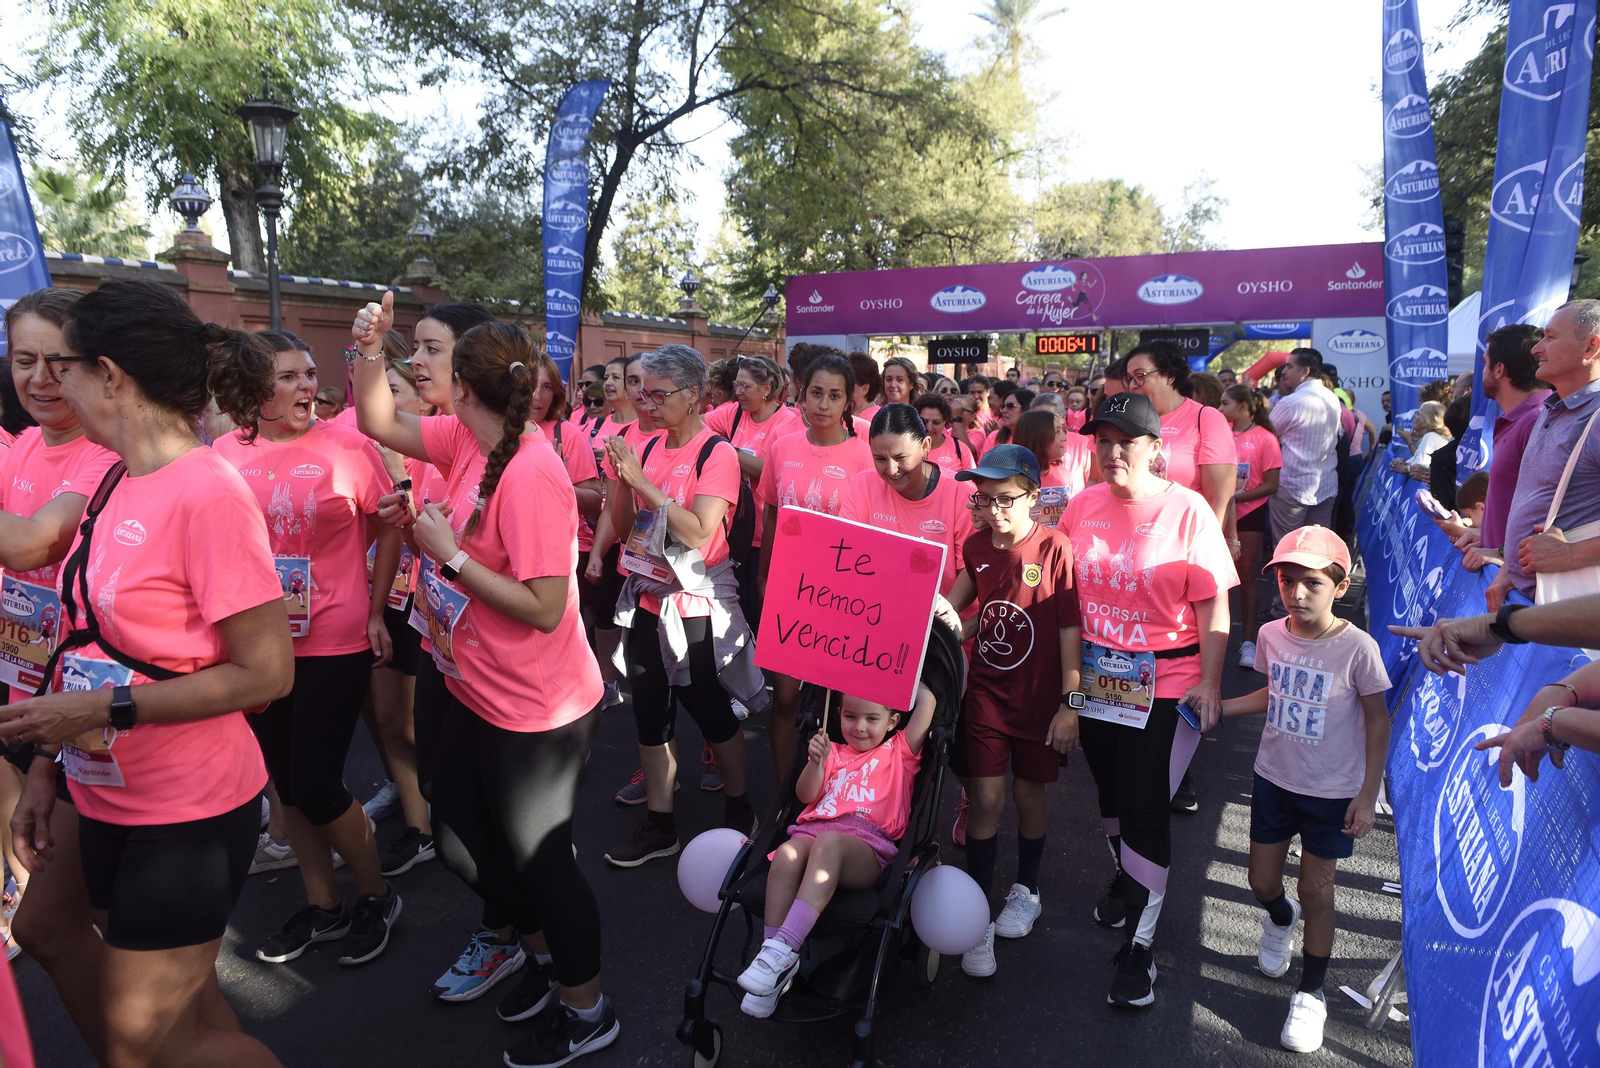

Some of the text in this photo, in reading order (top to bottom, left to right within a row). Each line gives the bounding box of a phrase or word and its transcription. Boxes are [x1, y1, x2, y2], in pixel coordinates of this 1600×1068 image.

[547, 258, 581, 270] STURIANA
[1025, 276, 1073, 287] ASTURIANA
[1237, 279, 1293, 294] OYSHO
[1327, 279, 1384, 291] Santander
[1015, 290, 1062, 305] Carrera
[1141, 287, 1198, 298] ASTURIANA
[547, 301, 578, 313] TURIANA
[860, 298, 903, 311] OYSHO
[934, 296, 982, 307] ASTURIANA
[796, 304, 835, 314] Santander
[1026, 301, 1079, 325] de la Mujer
[1331, 339, 1381, 350] ASTURIANA
[937, 346, 980, 358] OYSHO
[1338, 376, 1385, 389] YSHO
[783, 461, 804, 469] OYSHO
[1080, 519, 1111, 530] OYSHO
[830, 538, 876, 576] te
[983, 606, 1028, 631] ANDEX
[1087, 601, 1150, 623] DORSAL
[1083, 615, 1149, 647] UMA
[1, 641, 19, 655] 3900
[466, 638, 480, 647] 2022
[17, 657, 35, 670] MUJER
[1100, 659, 1131, 670] ASTURIANA
[1098, 675, 1131, 692] 016
[1272, 662, 1325, 702] PARA
[1090, 696, 1109, 705] CARRERA
[1105, 692, 1122, 701] 5150
[1123, 713, 1142, 722] Santander
[1268, 694, 1321, 737] DISE
[1470, 757, 1512, 866] CENTRAL LECHERA
[1446, 749, 1499, 924] ASTURIANA
[1539, 954, 1581, 1067] CENTRAL
